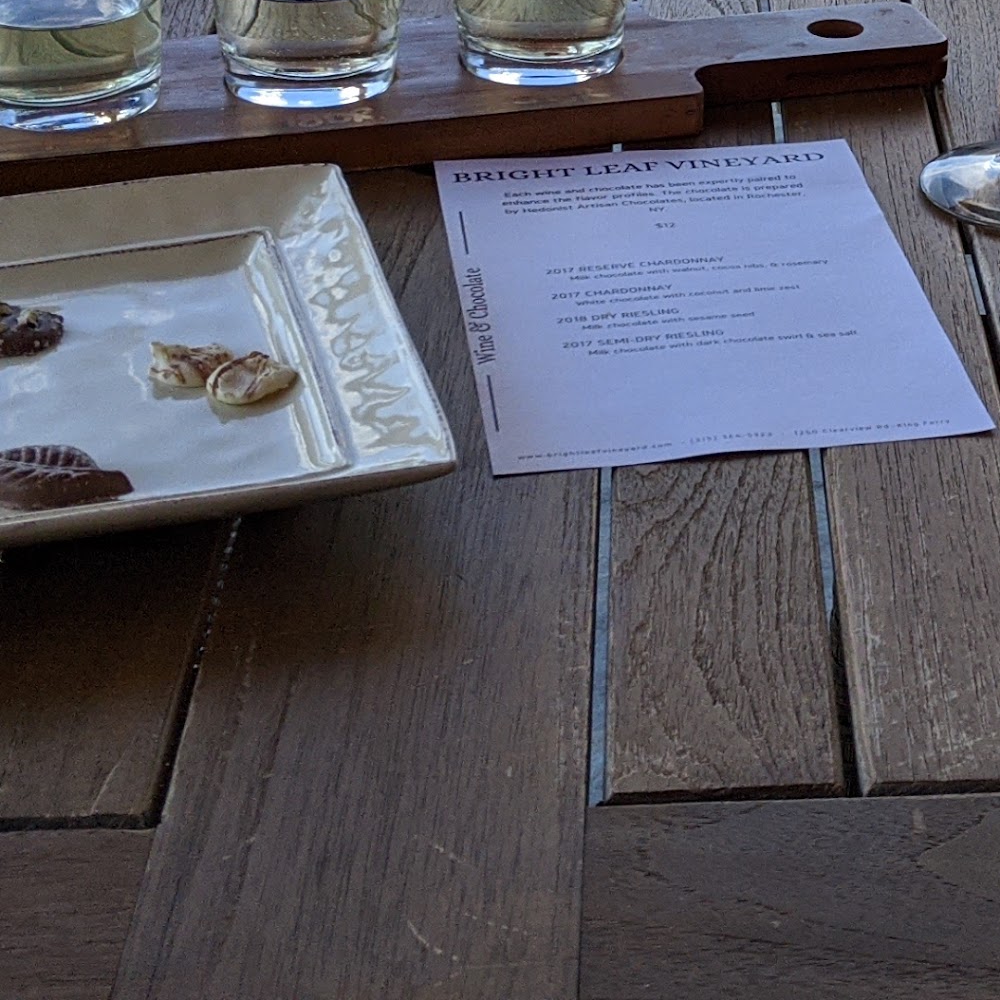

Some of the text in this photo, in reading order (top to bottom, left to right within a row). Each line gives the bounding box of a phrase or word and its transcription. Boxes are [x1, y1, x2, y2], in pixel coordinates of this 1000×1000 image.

[452, 152, 825, 184] BRIGHT LEAF VINEYARD
[502, 198, 550, 207] enhance
[553, 196, 572, 204] the
[575, 193, 607, 202] flavor
[662, 189, 682, 197] The
[685, 186, 739, 196] chocolate
[741, 184, 751, 192] is
[753, 182, 804, 192] prepared
[503, 173, 797, 199] Each wine and chocolate has been expertly paired to
[545, 256, 724, 275] 2017 RESERVE CHARDONNAY
[593, 270, 644, 280] chocolate
[646, 268, 670, 276] with
[551, 284, 673, 300] 2017 CHARDONNAY
[575, 298, 606, 306] White
[609, 294, 660, 304] chocolate
[662, 291, 687, 299] with
[462, 267, 496, 365] Wine & Chocolate
[556, 307, 680, 324] 2018 DRY RIESLING
[606, 319, 659, 329] chocolate
[661, 316, 686, 325] with
[562, 329, 725, 349] 2017 SEMI-DRY RIESLING
[613, 344, 666, 355] chocolate
[668, 341, 694, 349] with
[696, 338, 720, 347] dark
[723, 335, 775, 345] chocolate
[838, 329, 859, 337] salt
